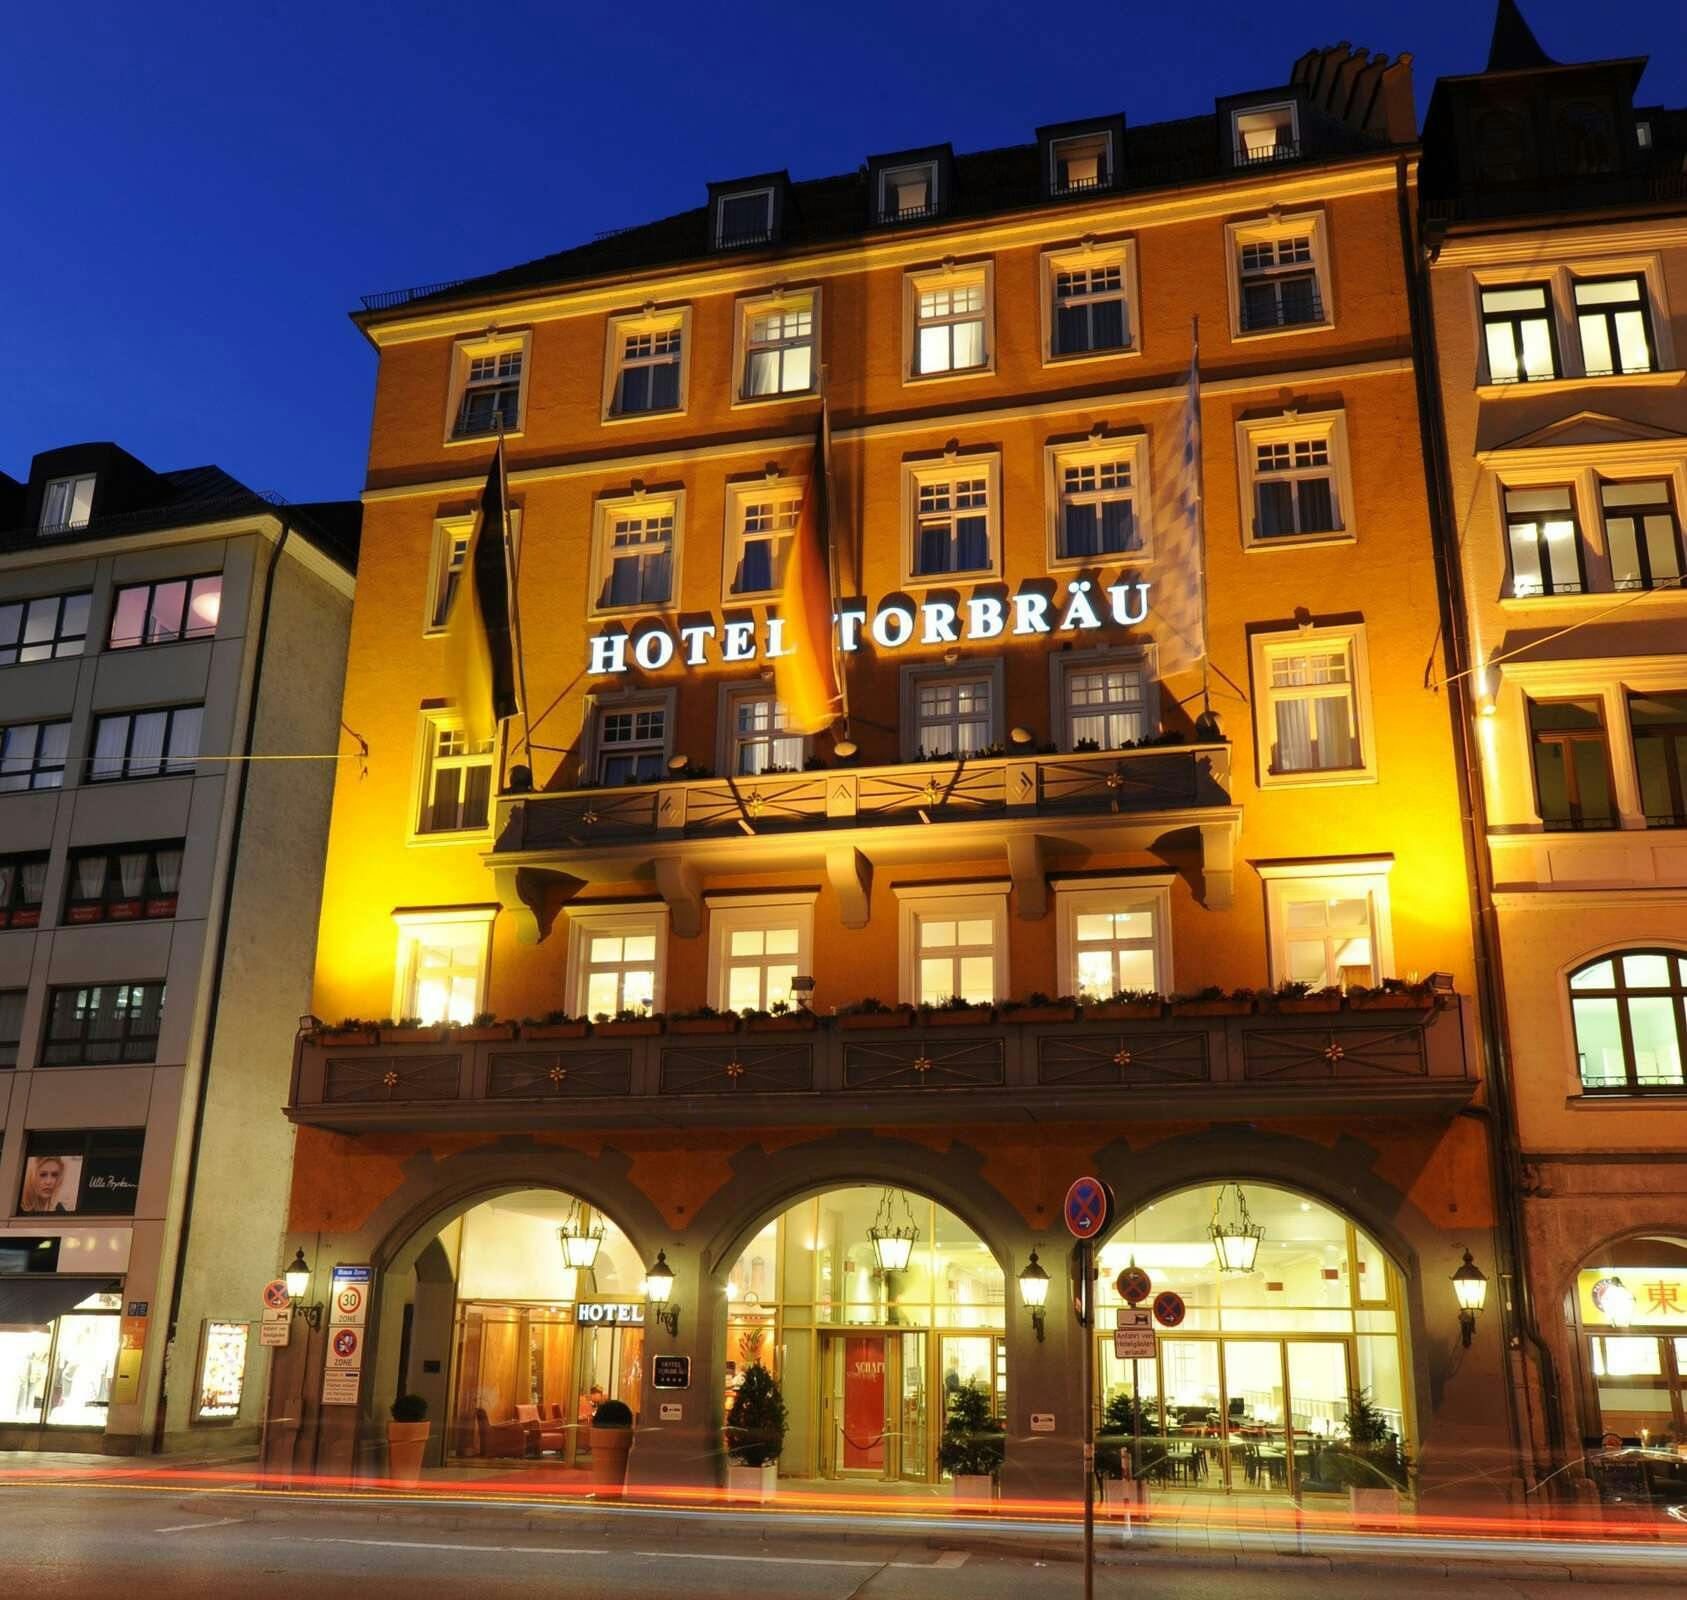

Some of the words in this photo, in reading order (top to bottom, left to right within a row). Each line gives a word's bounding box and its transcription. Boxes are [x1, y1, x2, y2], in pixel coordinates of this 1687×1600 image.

[587, 618, 797, 675] HOTEL
[832, 582, 1151, 651] TORBRÄU
[342, 1294, 357, 1307] 30
[1642, 1280, 1687, 1315] 東
[338, 1315, 356, 1323] ZONE
[578, 1303, 645, 1321] HOTEL
[334, 1358, 353, 1367] ZONE
